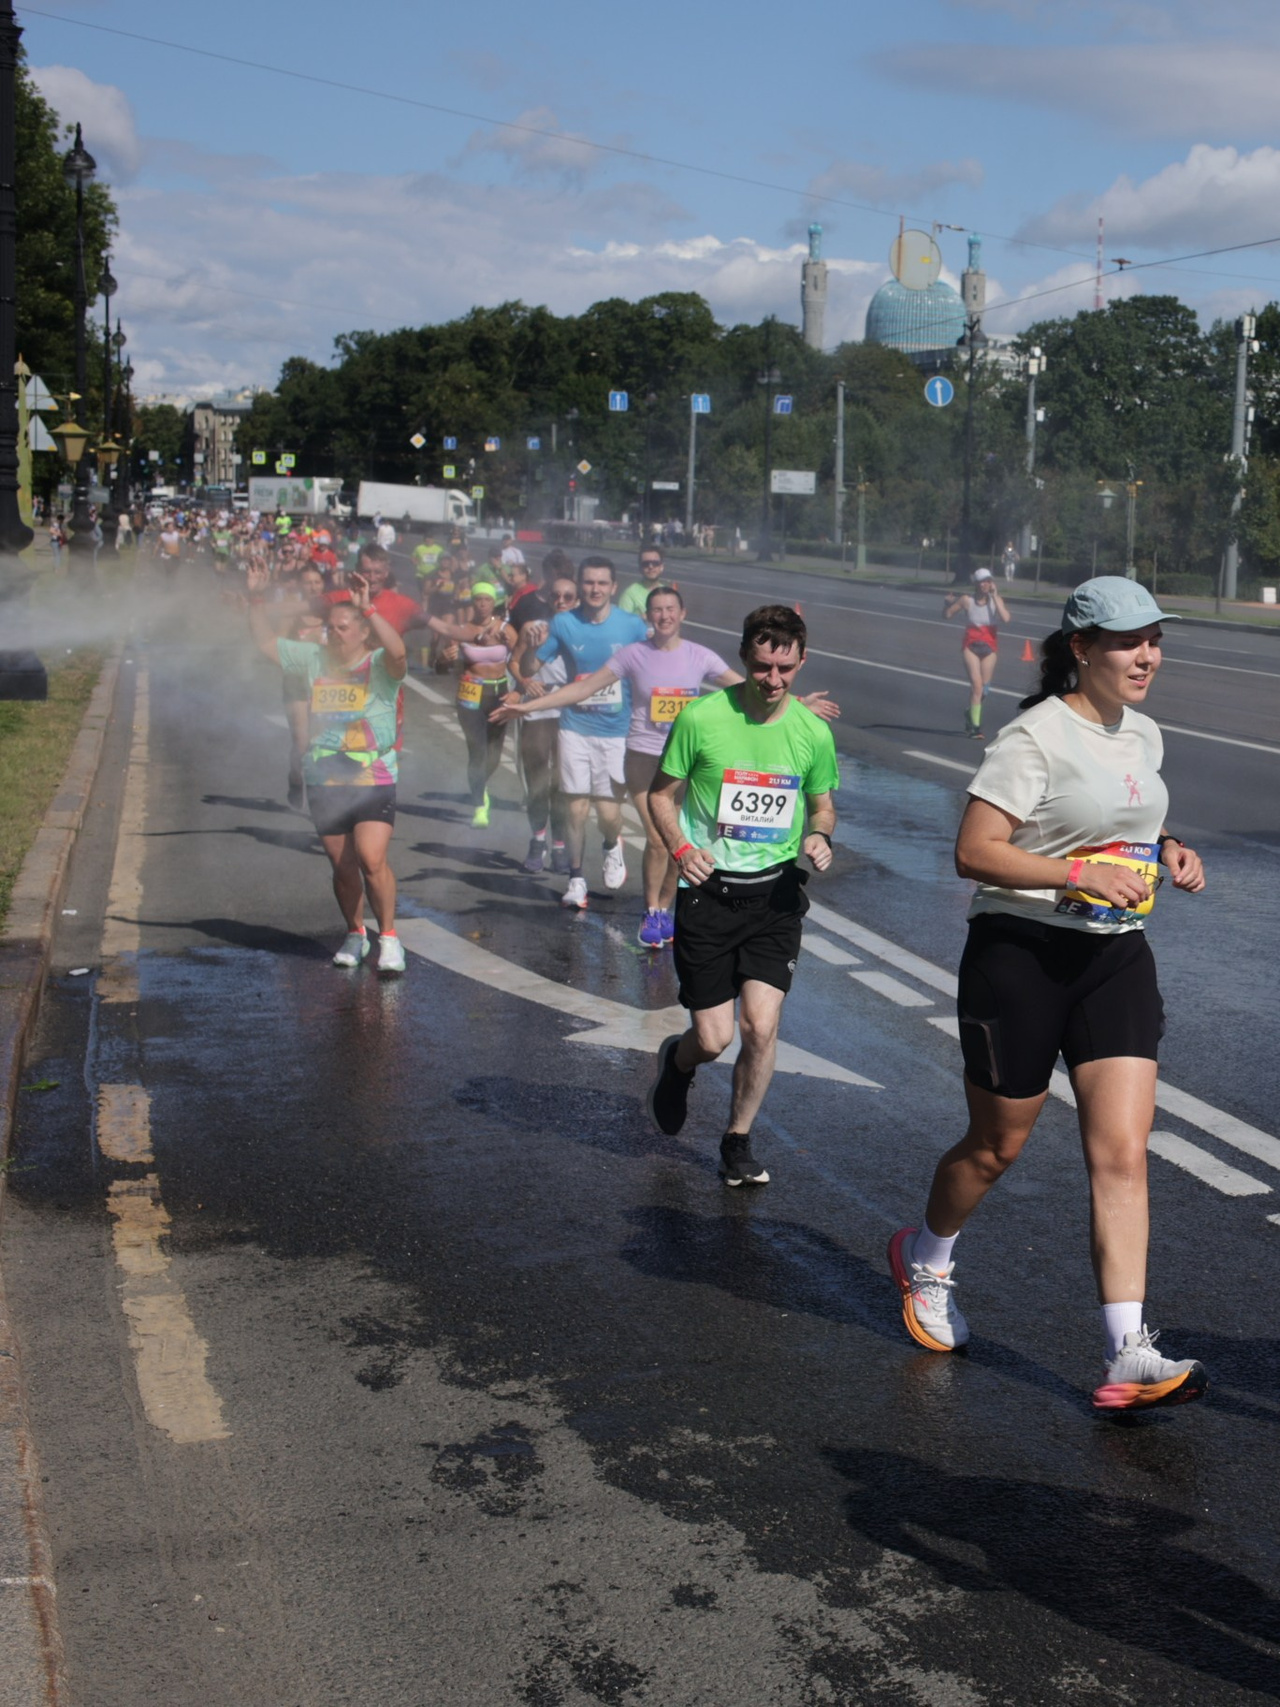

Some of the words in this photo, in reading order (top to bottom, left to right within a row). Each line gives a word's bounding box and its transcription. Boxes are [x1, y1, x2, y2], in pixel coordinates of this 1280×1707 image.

[318, 688, 358, 704] 3986
[658, 700, 690, 714] 231
[730, 791, 787, 815] 6399
[740, 815, 774, 824] ВИТАЛИЙ
